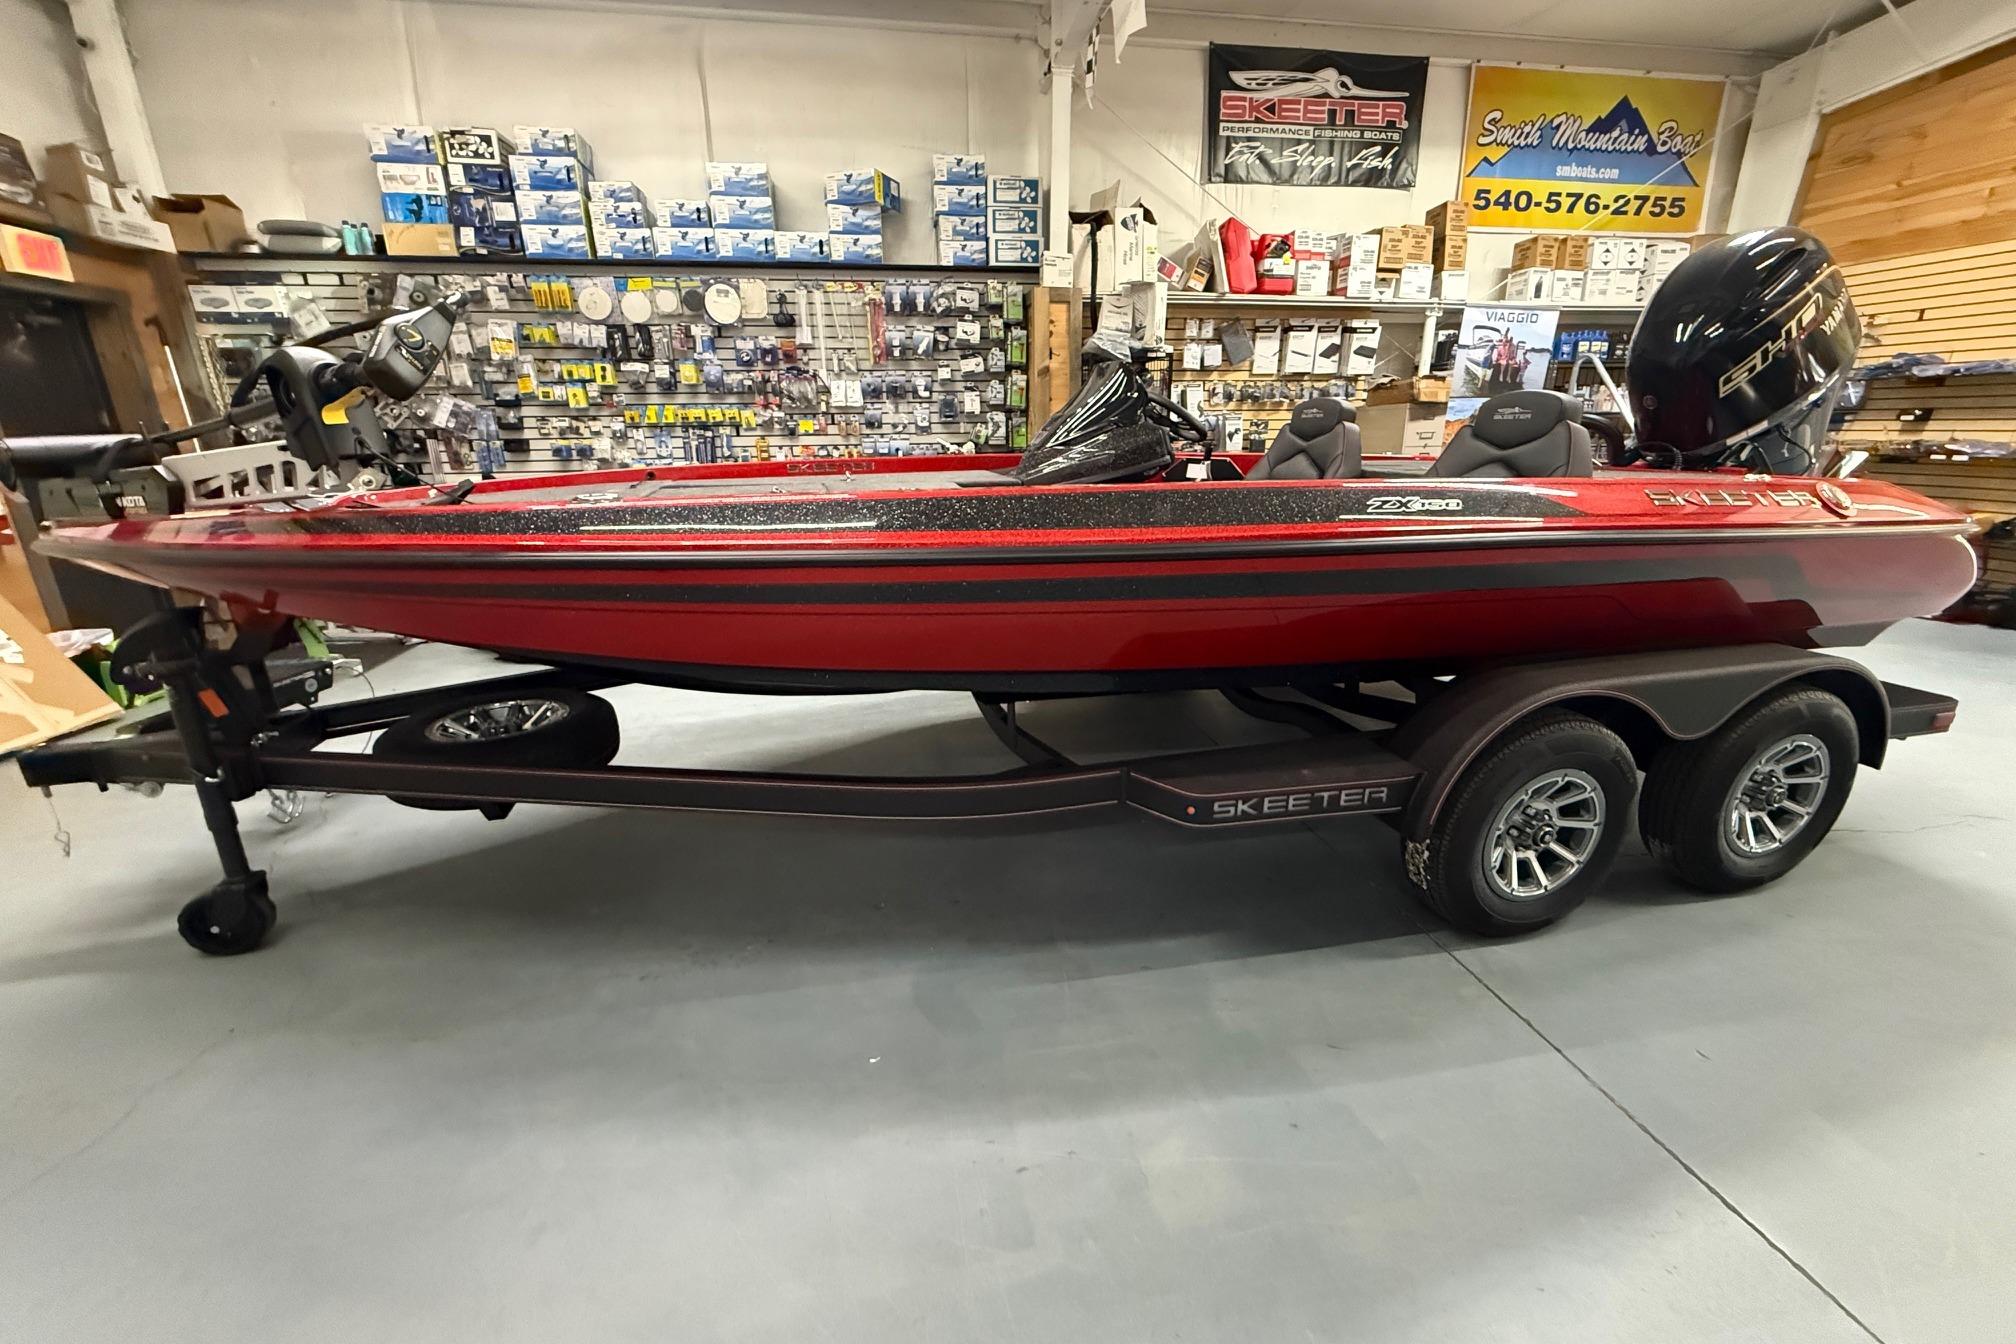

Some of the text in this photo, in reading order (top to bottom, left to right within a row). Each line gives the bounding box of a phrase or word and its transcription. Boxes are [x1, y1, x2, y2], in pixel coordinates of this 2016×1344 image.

[1220, 93, 1406, 127] SKEETER
[1222, 125, 1400, 141] PERFORMANCE FISHING BOATS
[1476, 109, 1546, 147] Smith
[1550, 112, 1649, 155] Mountain
[1224, 142, 1399, 179] Eat. Sleep. Fish.
[1556, 163, 1619, 180] smboats.com
[1472, 188, 1686, 218] 540-576-2755
[1485, 311, 1539, 325] VIAGGIO
[1644, 489, 1817, 509] SKEETER
[1213, 786, 1388, 819] SKEETER
